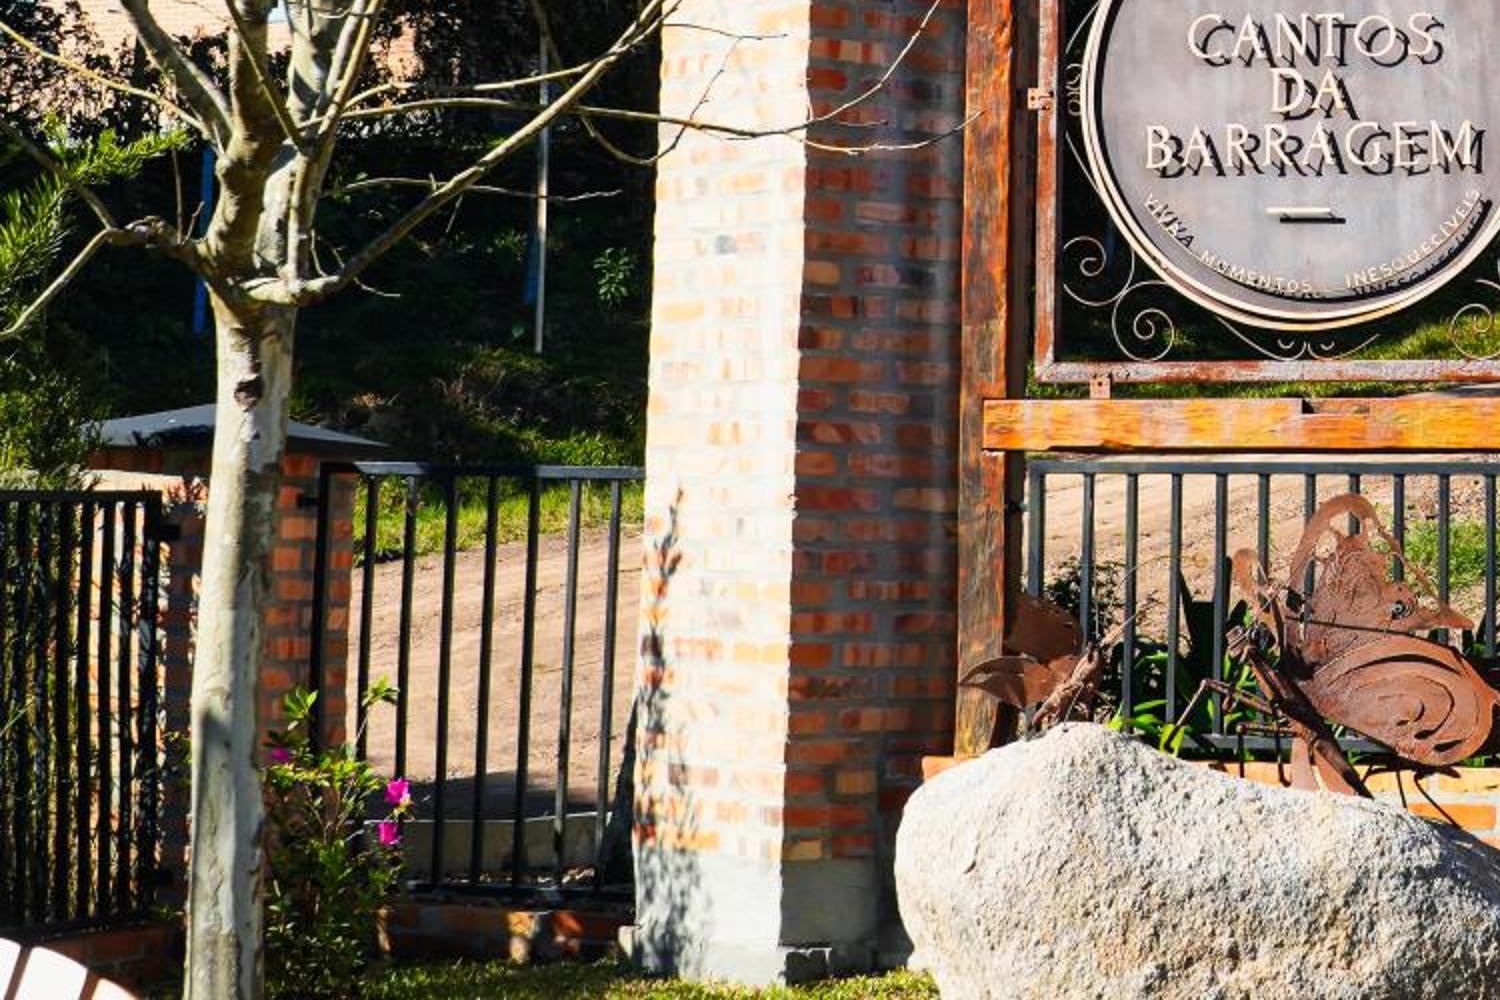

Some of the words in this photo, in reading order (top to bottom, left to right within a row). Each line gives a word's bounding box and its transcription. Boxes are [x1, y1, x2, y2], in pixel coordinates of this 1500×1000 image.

[1187, 13, 1435, 60] CANTOS
[1269, 66, 1346, 113] DA
[1144, 119, 1475, 169] BARRAGEM
[1199, 249, 1313, 293] MOMENTOS
